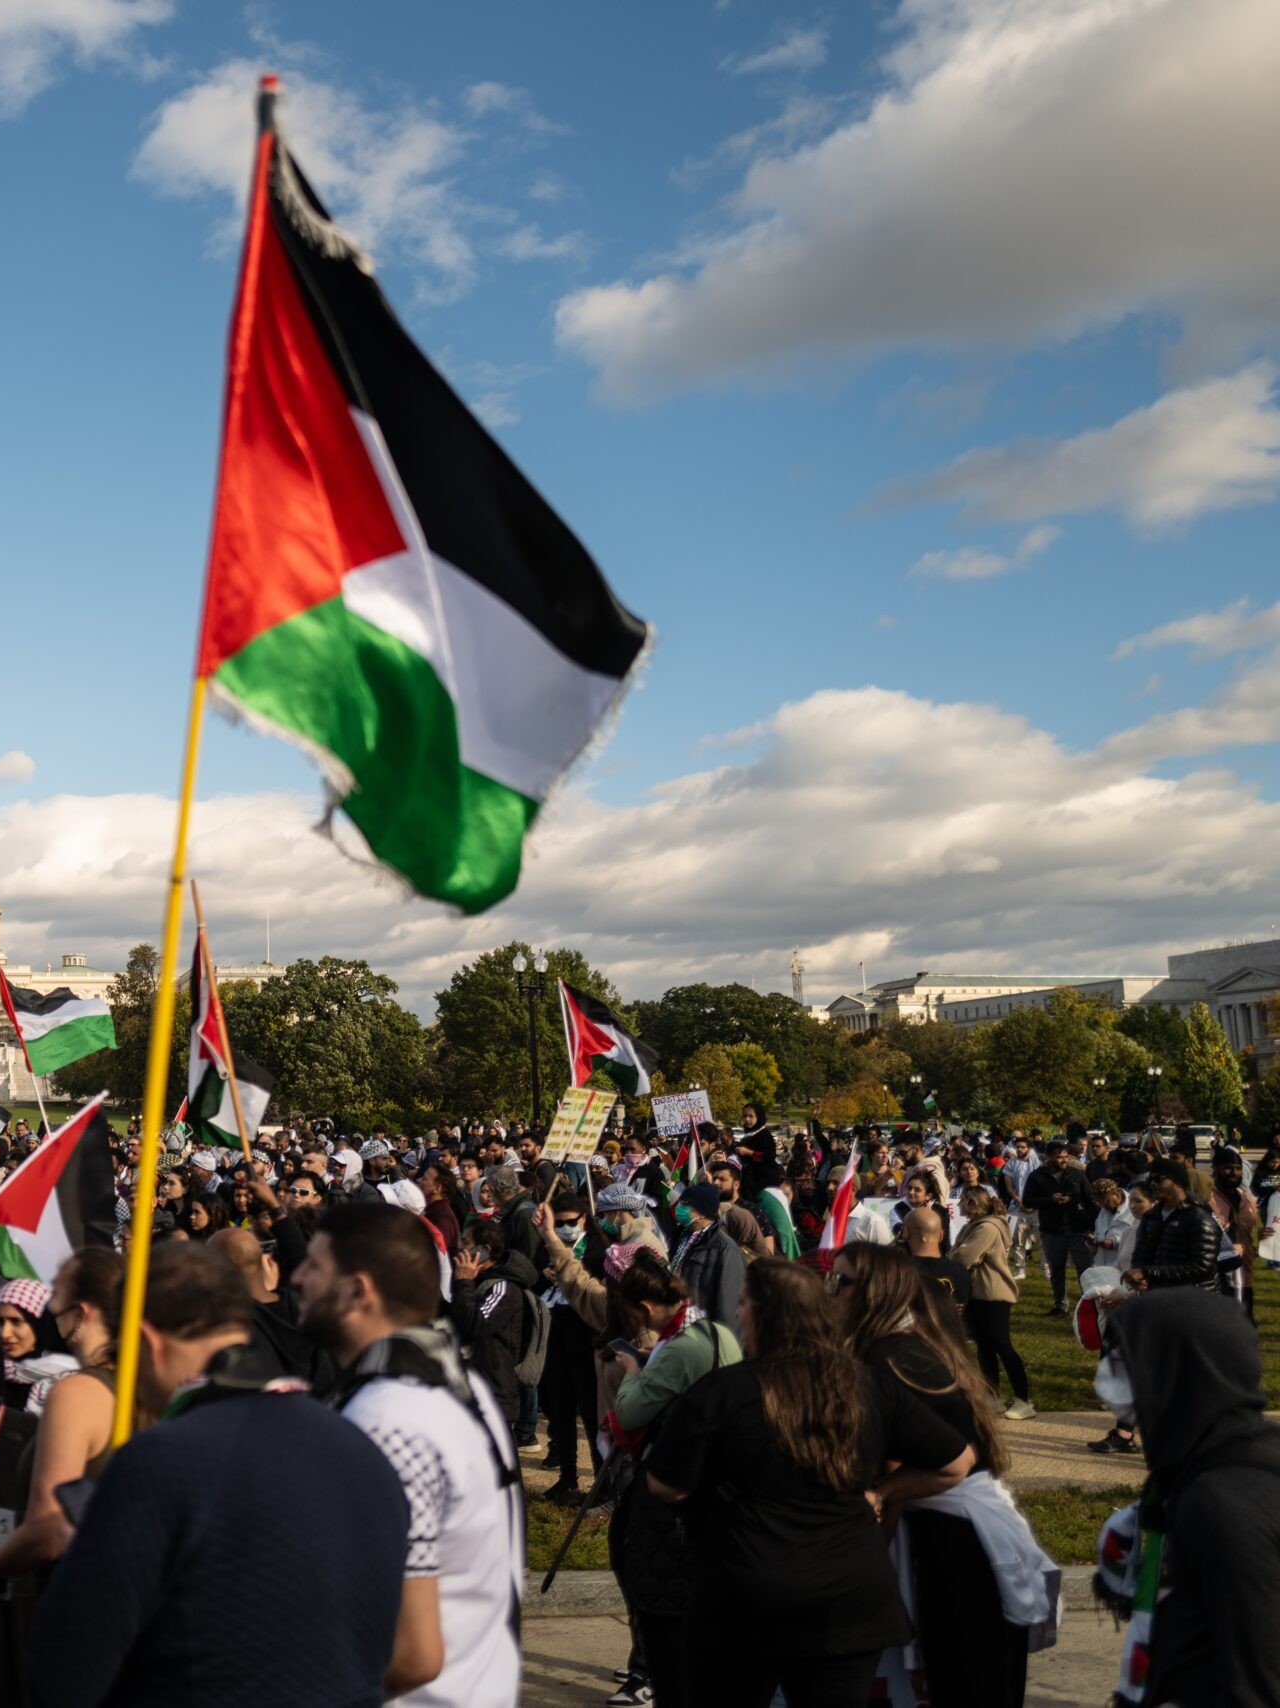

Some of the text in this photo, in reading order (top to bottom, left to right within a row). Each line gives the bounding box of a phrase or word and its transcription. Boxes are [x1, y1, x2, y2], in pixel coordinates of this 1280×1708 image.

[653, 1093, 691, 1105] INJUSTICE
[657, 1114, 667, 1122] IS
[668, 1113, 676, 1121] A
[657, 1123, 691, 1136] EVERYWHE
